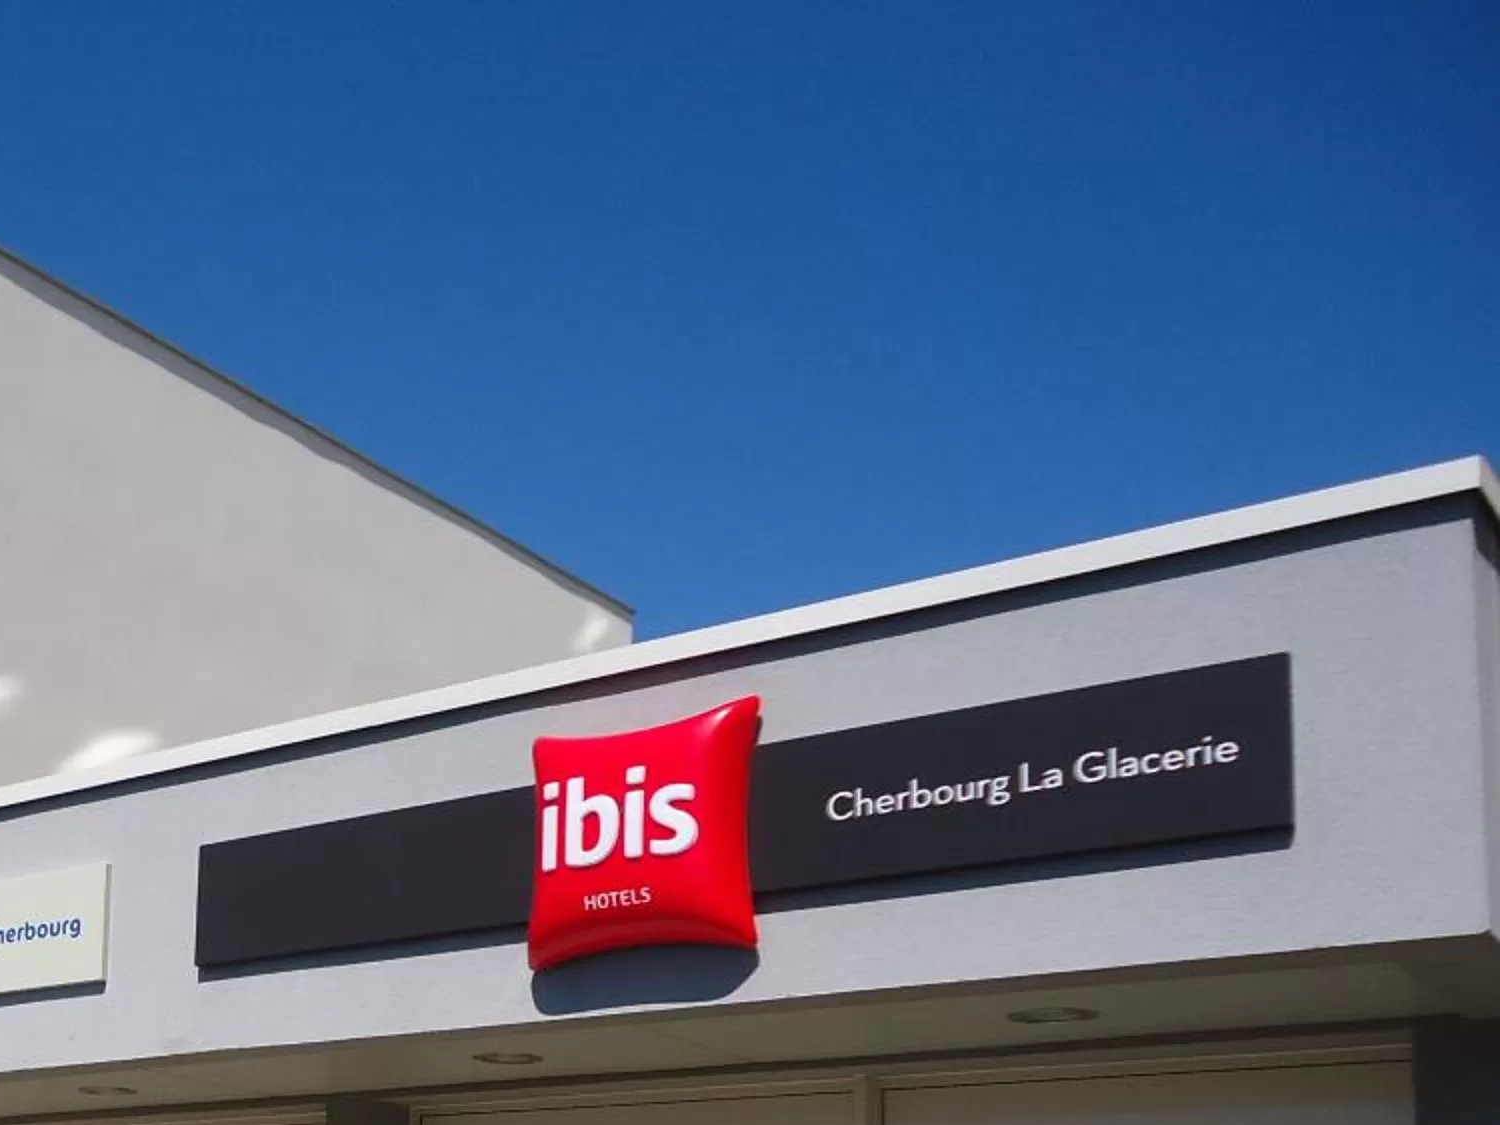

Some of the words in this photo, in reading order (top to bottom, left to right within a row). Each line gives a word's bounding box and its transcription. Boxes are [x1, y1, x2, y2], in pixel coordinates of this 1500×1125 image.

[541, 764, 700, 873] ibis
[826, 776, 1011, 822] Cherbourg
[1019, 762, 1064, 793] La
[1073, 735, 1240, 784] Glacerie
[583, 886, 652, 911] HOTELS
